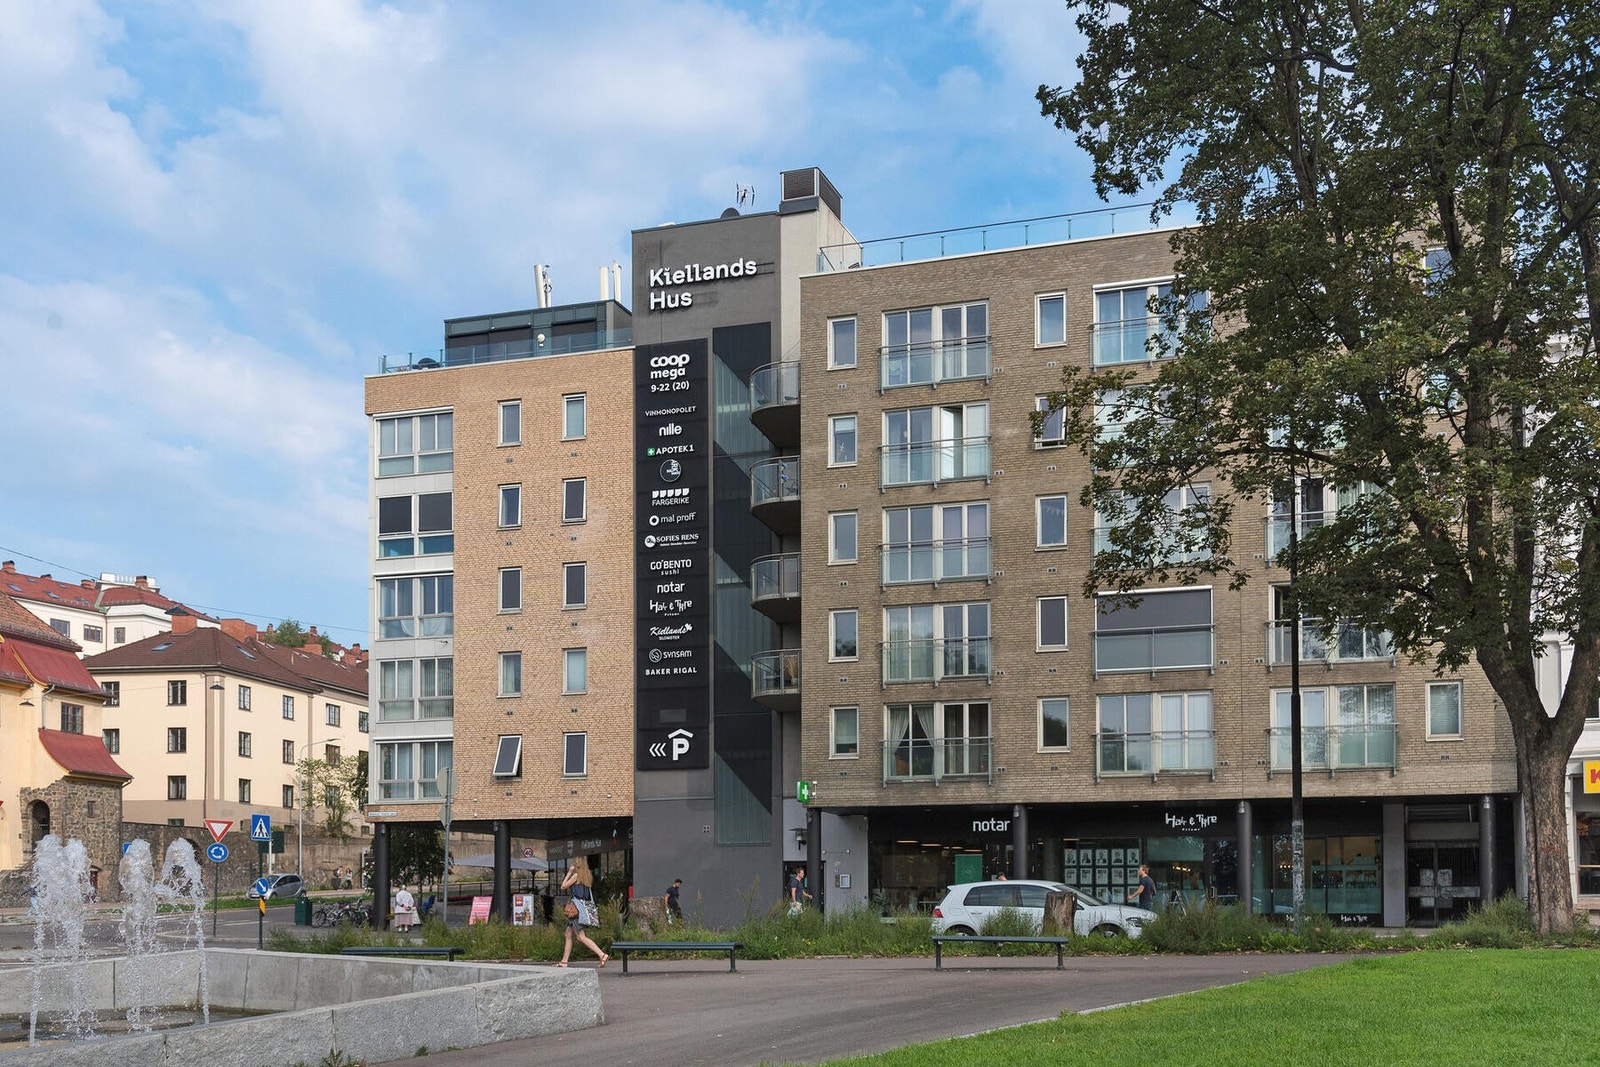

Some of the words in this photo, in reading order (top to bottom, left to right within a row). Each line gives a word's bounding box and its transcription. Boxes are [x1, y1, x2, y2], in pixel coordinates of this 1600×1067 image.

[650, 258, 757, 287] Kiellands
[650, 291, 692, 310] Hus
[650, 354, 690, 367] coop
[650, 368, 686, 380] mega
[651, 383, 670, 392] 9-22
[672, 381, 690, 391] (20)
[645, 406, 696, 416] VINMONOPOLET
[659, 423, 682, 436] nille
[656, 446, 688, 455] APOTEK
[652, 497, 690, 506] FARGERIKE
[661, 514, 675, 523] mal
[677, 512, 697, 524] proff
[656, 535, 680, 543] SOFIES
[657, 582, 686, 594] notar
[973, 818, 1011, 832] notar
